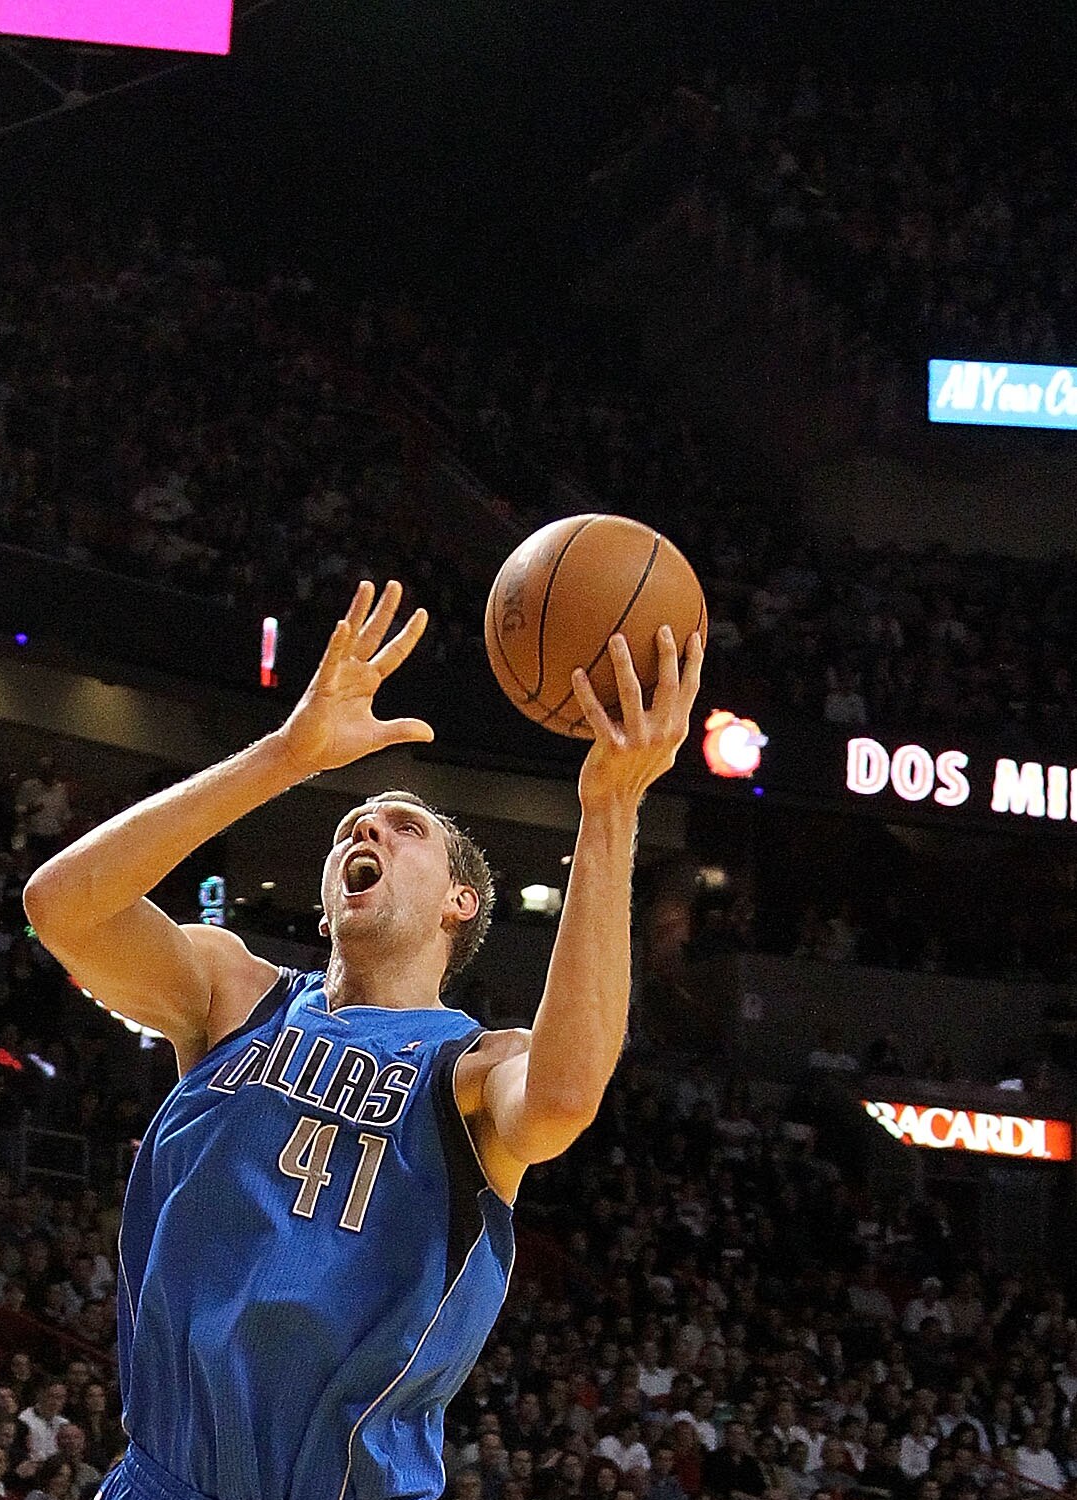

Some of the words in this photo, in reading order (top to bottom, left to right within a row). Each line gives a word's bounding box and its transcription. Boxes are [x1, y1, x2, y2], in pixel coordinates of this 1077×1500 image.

[846, 738, 970, 806] DOS
[991, 758, 1077, 822] MI
[278, 1116, 388, 1232] 41
